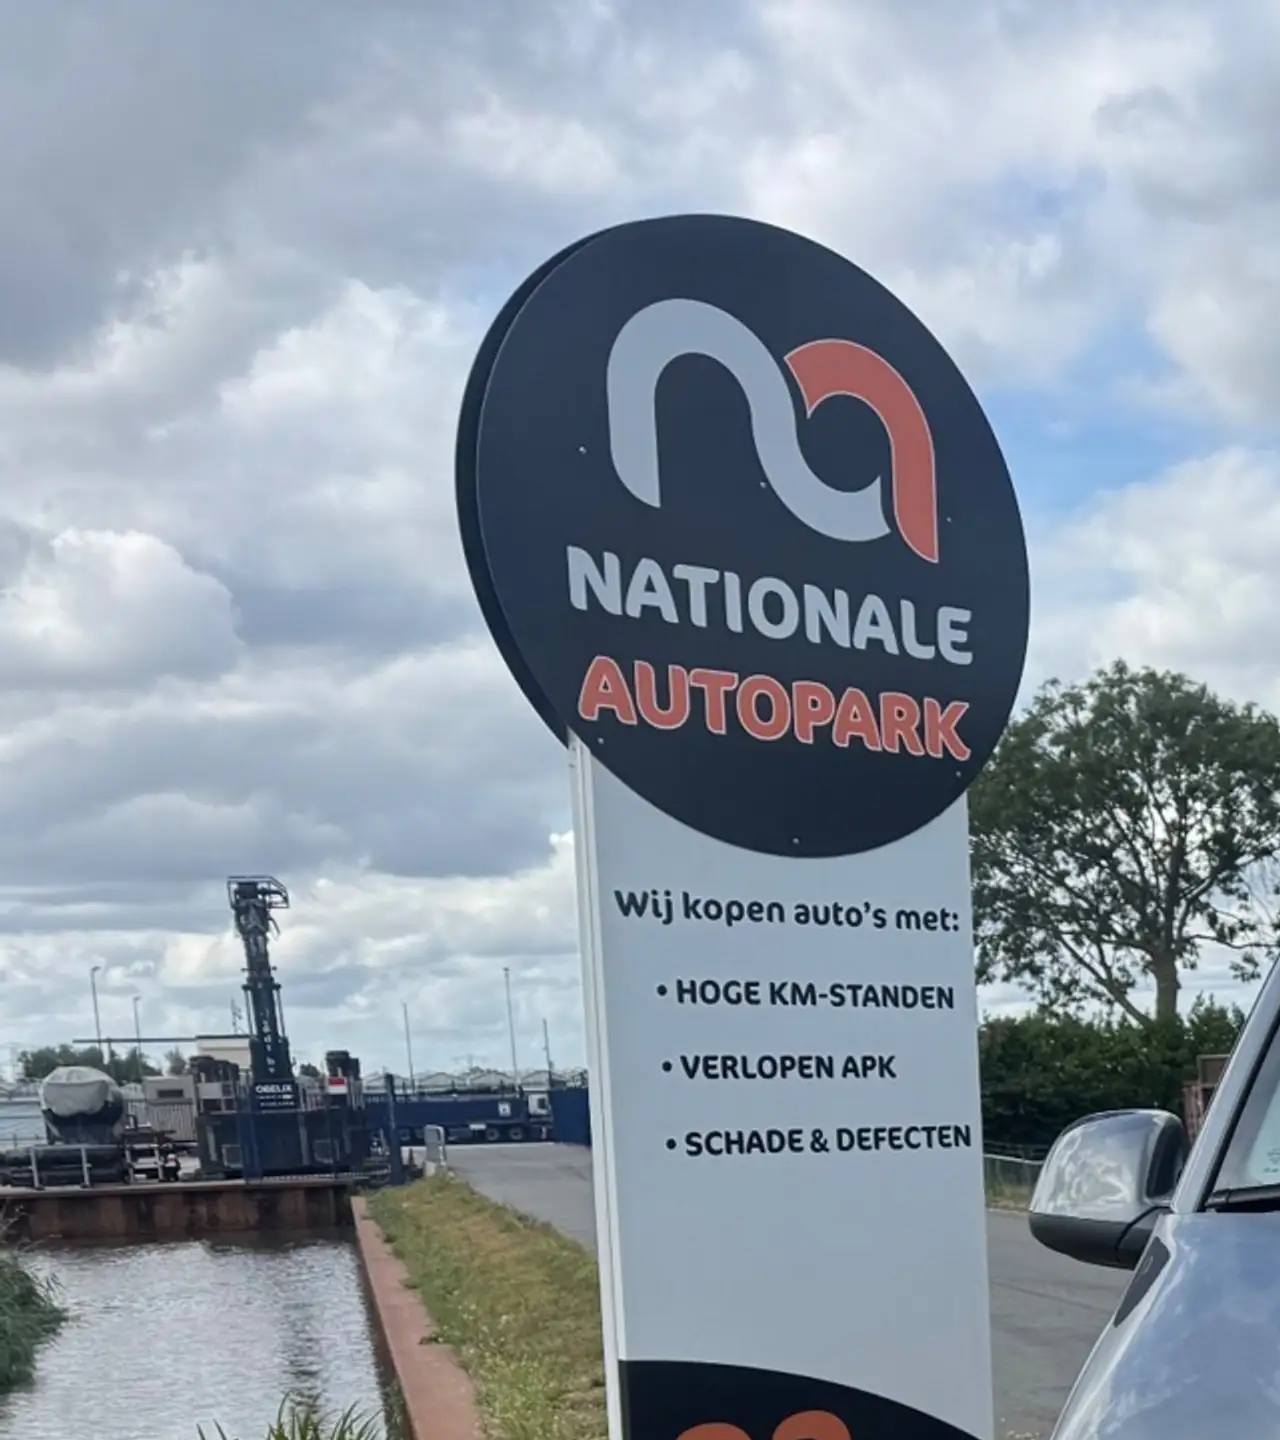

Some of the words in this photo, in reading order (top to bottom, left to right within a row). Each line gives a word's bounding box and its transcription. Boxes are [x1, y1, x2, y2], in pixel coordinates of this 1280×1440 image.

[566, 545, 974, 666] NATIONALE
[578, 655, 971, 761] AUTOPARK
[614, 889, 674, 926] Wij
[682, 891, 786, 927] kopen
[794, 901, 888, 929] auto's
[895, 907, 960, 932] met:
[676, 979, 762, 1006] HOGE
[769, 981, 955, 1010] KM-STANDEN
[680, 1055, 834, 1080] VERLOPEN
[841, 1055, 898, 1079] APK
[684, 1128, 805, 1157] SCHADE
[809, 1128, 830, 1154] &
[836, 1124, 972, 1152] DEFECTEN
